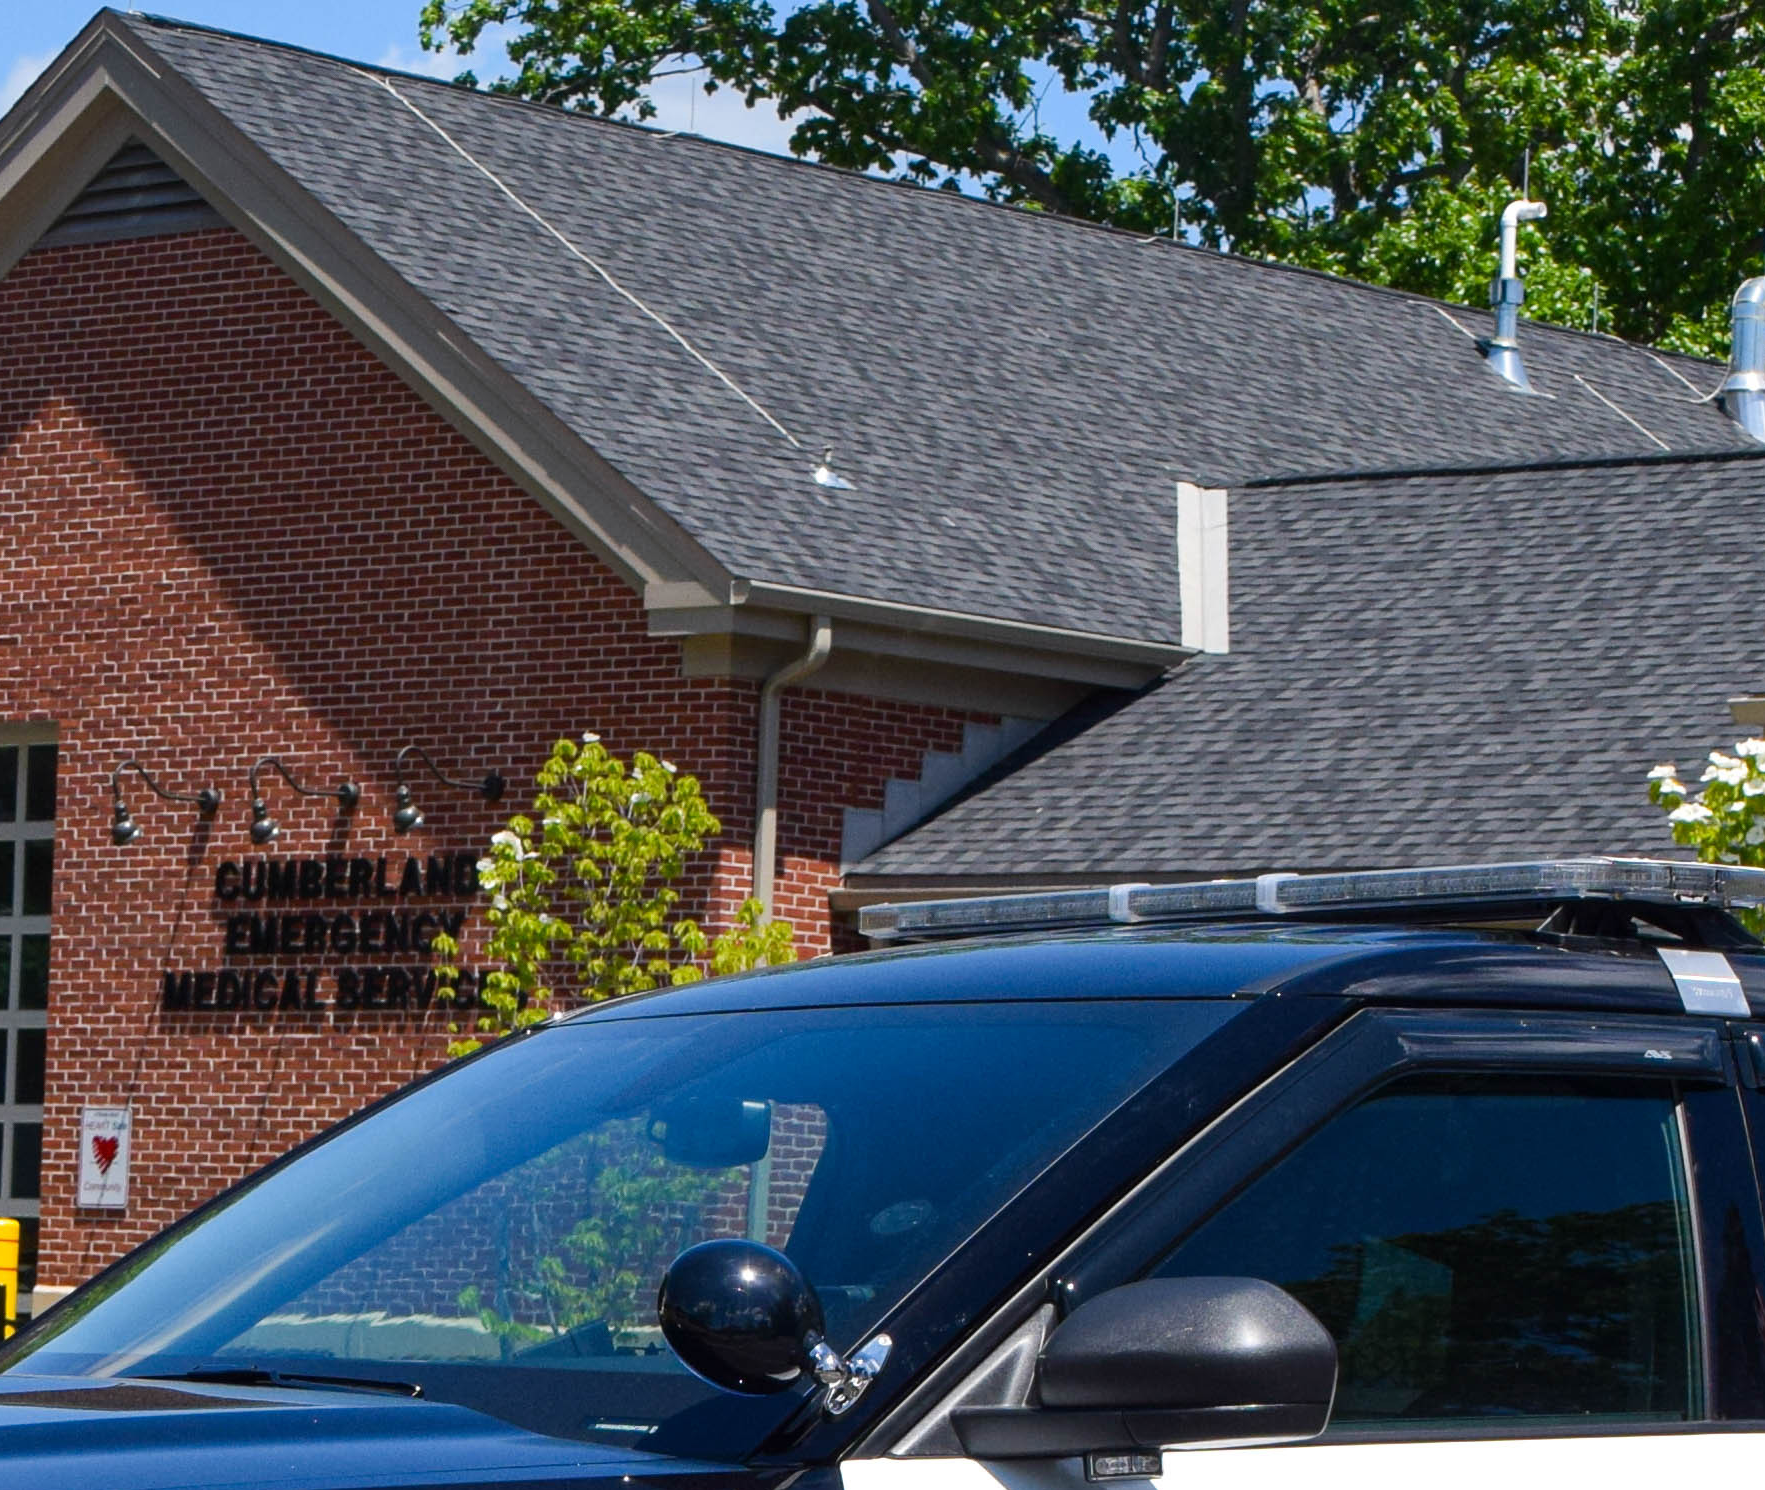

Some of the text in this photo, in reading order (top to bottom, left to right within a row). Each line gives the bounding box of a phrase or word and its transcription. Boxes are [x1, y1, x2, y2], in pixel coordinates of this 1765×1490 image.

[216, 855, 479, 899] CUMBERLAND
[225, 912, 465, 954] EMERGENCY
[163, 966, 528, 1010] MEDICAL SERVC
